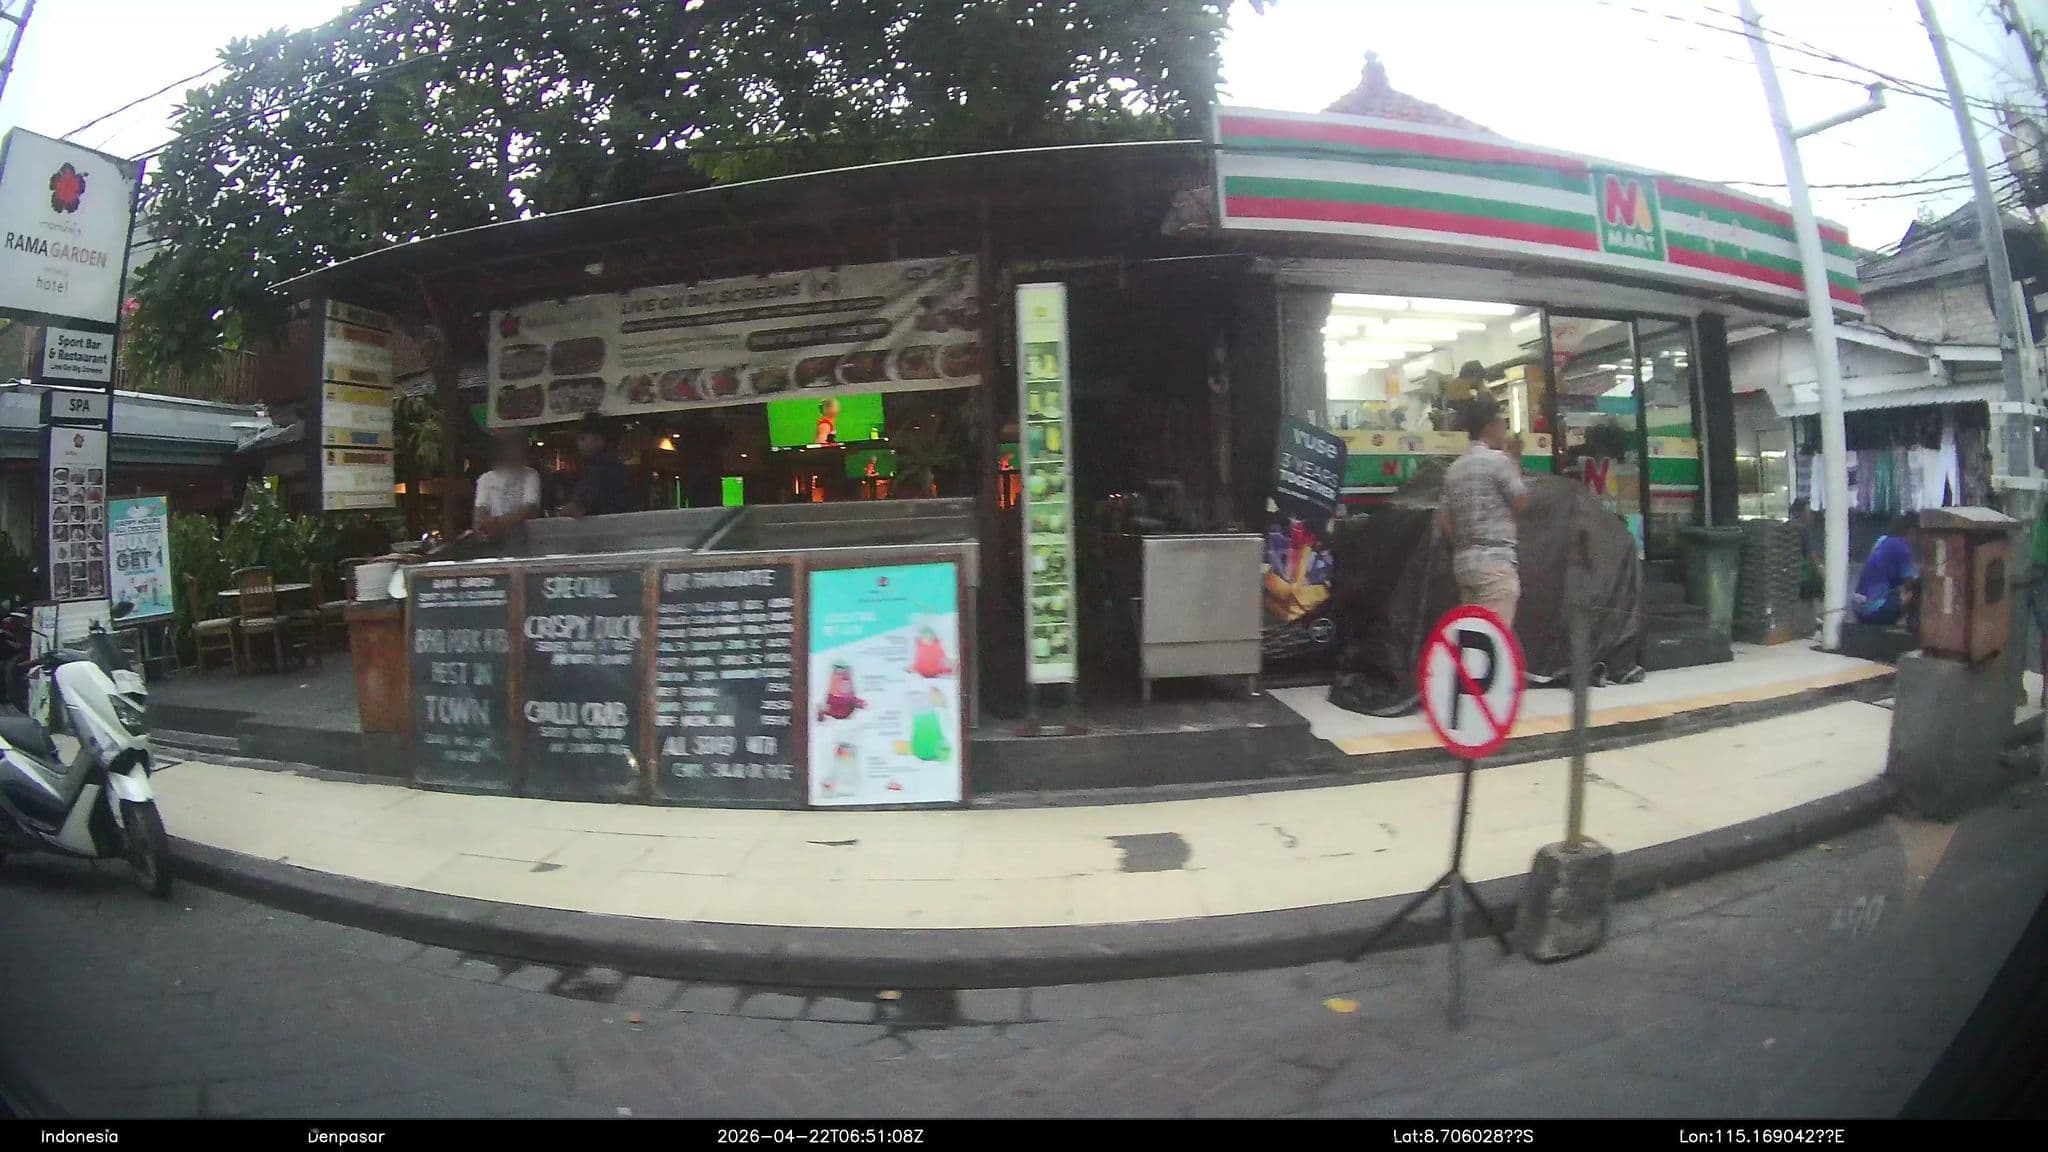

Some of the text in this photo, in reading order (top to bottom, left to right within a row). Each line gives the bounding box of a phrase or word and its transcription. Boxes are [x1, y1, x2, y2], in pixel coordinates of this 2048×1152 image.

[4, 231, 108, 269] RAMA GARDEN
[1607, 230, 1656, 252] MART
[36, 275, 69, 293] hotel
[57, 334, 102, 350] Sport Bar
[48, 348, 108, 365] & Restaurant
[69, 398, 90, 412] SPA
[116, 551, 153, 571] GET
[1448, 629, 1496, 730] P
